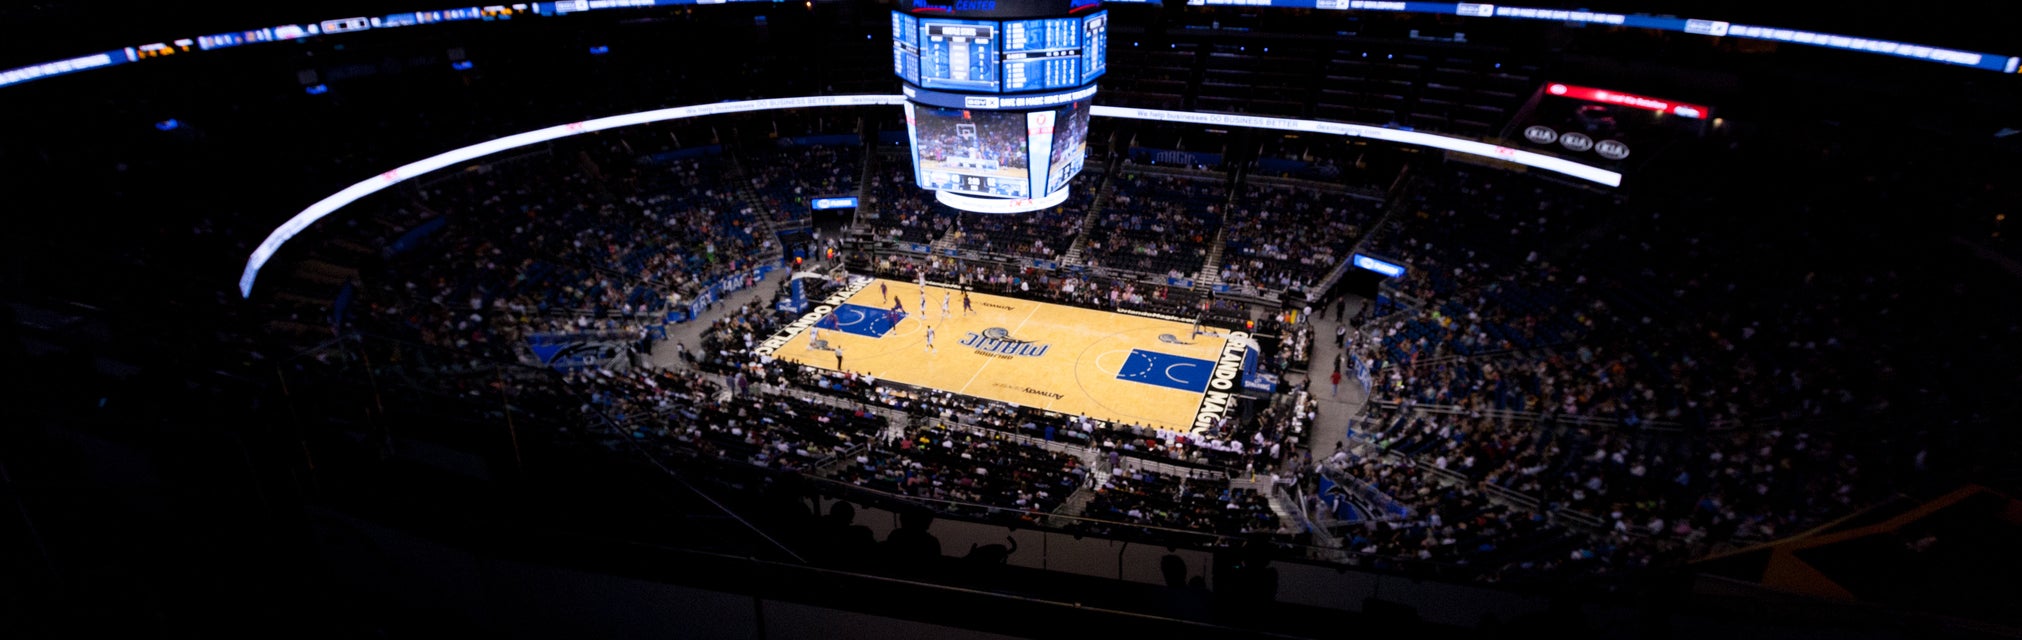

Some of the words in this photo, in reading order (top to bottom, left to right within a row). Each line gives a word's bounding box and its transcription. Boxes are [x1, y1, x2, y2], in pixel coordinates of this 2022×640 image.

[956, 0, 996, 11] CENTER
[1209, 115, 1222, 123] DO
[1223, 116, 1264, 126] BUSINESS
[1265, 118, 1299, 129] BETTER
[754, 304, 834, 356] ORLANDO
[958, 332, 1051, 357] MAGIC
[1022, 387, 1065, 400] Amway
[1191, 390, 1230, 440] MAGIC
